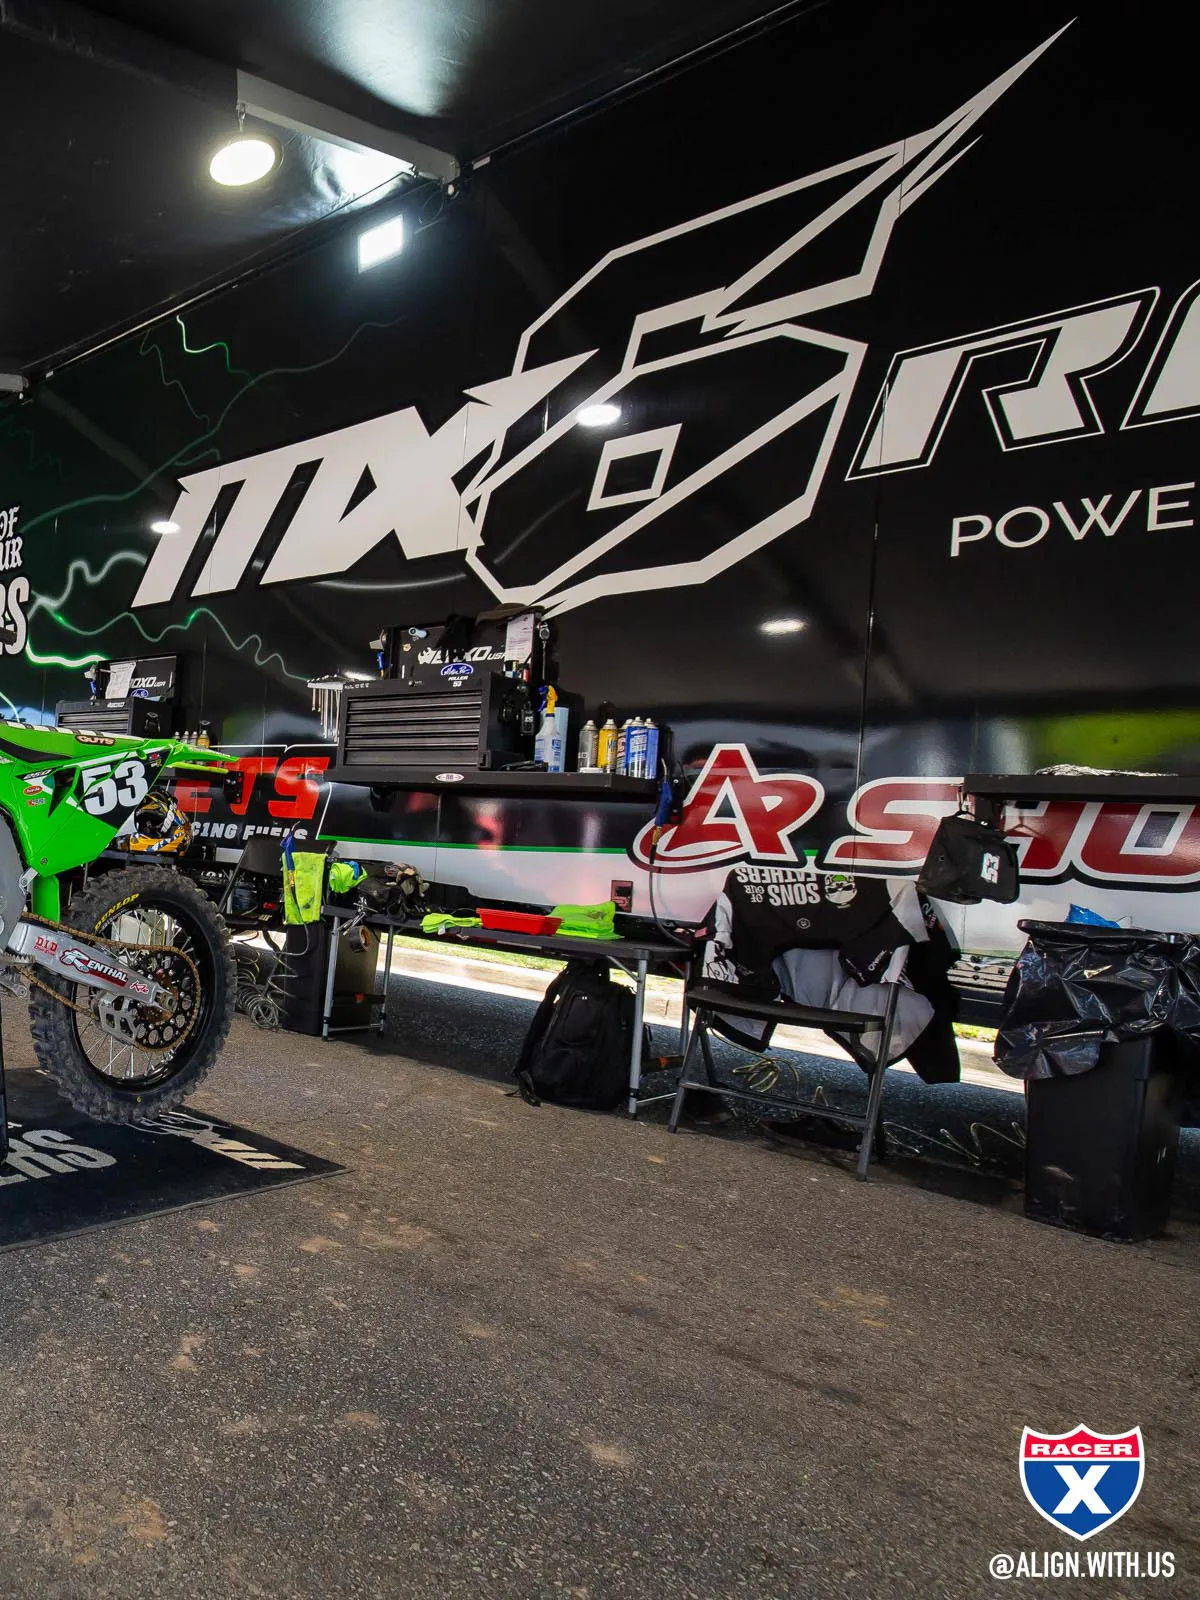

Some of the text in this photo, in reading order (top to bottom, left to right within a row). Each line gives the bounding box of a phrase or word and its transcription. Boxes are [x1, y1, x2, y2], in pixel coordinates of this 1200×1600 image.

[950, 481, 1196, 558] POWE
[77, 735, 115, 745] GUTS
[81, 760, 148, 816] 53
[191, 821, 238, 840] CING
[94, 892, 140, 931] DUNLOP
[767, 882, 821, 906] SONS
[59, 947, 129, 984] RENTHAL
